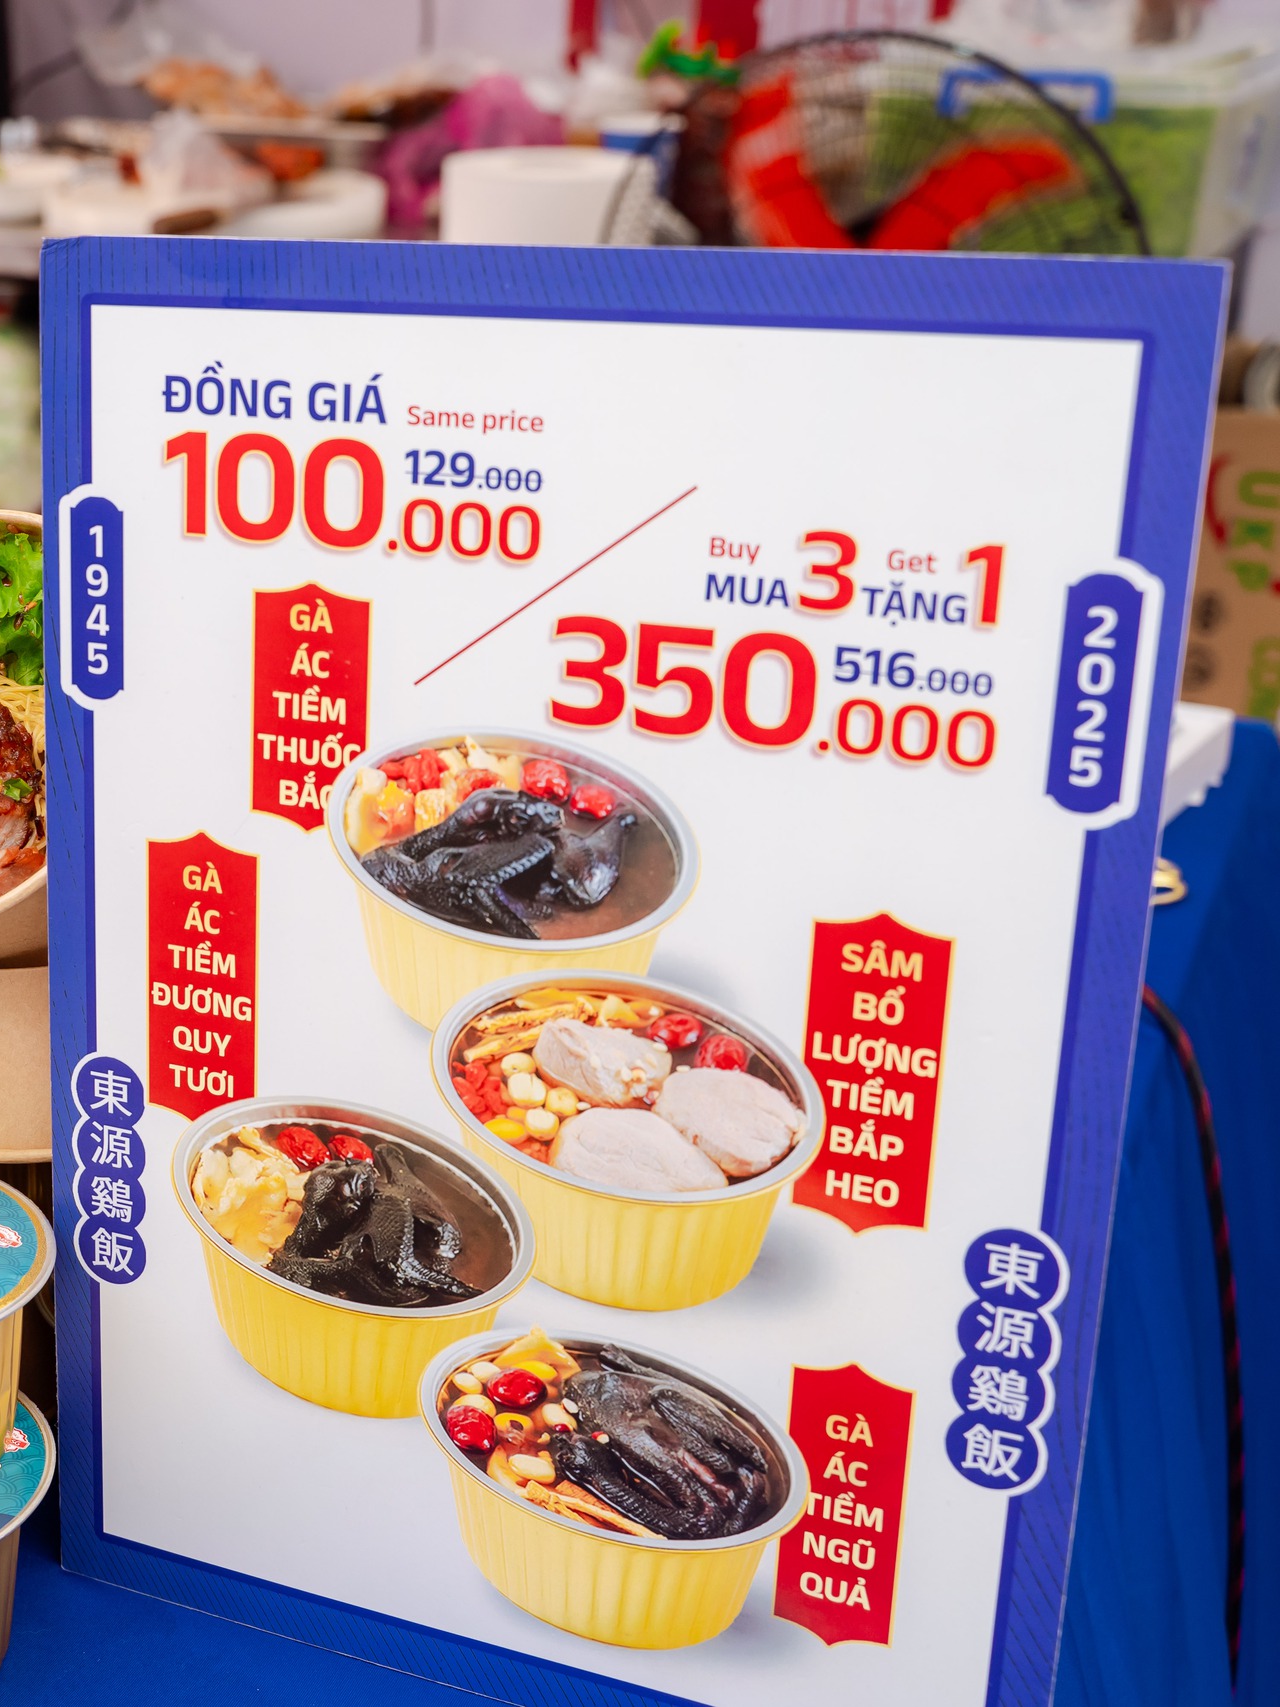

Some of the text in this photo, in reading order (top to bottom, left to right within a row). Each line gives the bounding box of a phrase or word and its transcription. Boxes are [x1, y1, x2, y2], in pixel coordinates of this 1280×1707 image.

[162, 361, 386, 424] ĐỒNG GIÁ
[407, 405, 544, 435] Same price
[405, 449, 543, 493] 129.000
[164, 430, 542, 563] 100.000
[710, 537, 760, 565] Buy
[887, 550, 938, 574] Get
[705, 529, 1006, 627] MUA 3 TẶNG 1
[85, 525, 110, 675] 1945
[290, 599, 333, 634] GÀ
[290, 643, 330, 678] ÁC
[834, 645, 993, 697] 516.000
[272, 686, 346, 725] TIỀM
[549, 615, 997, 770] 350.000
[1069, 605, 1118, 787] 2025
[258, 732, 361, 769] THUỐC
[182, 861, 222, 895] GÀ
[184, 902, 220, 935] ÁC
[167, 943, 236, 978] TIỀM
[841, 940, 923, 982] SÂM
[151, 981, 252, 1021] ĐƯƠNG
[852, 985, 905, 1026] BỔ
[172, 1025, 231, 1057] QUY
[812, 1031, 938, 1079] LƯỢNG
[169, 1064, 234, 1098] TƯƠI
[826, 1077, 915, 1121] TIỀM
[829, 1119, 904, 1162] BẮP
[825, 1169, 899, 1208] HEO
[825, 1413, 874, 1448] GÀ
[823, 1452, 868, 1487] ÁC
[807, 1491, 883, 1533] TIỀM
[802, 1531, 876, 1571] NGŨ
[799, 1571, 871, 1612] QUẢ
